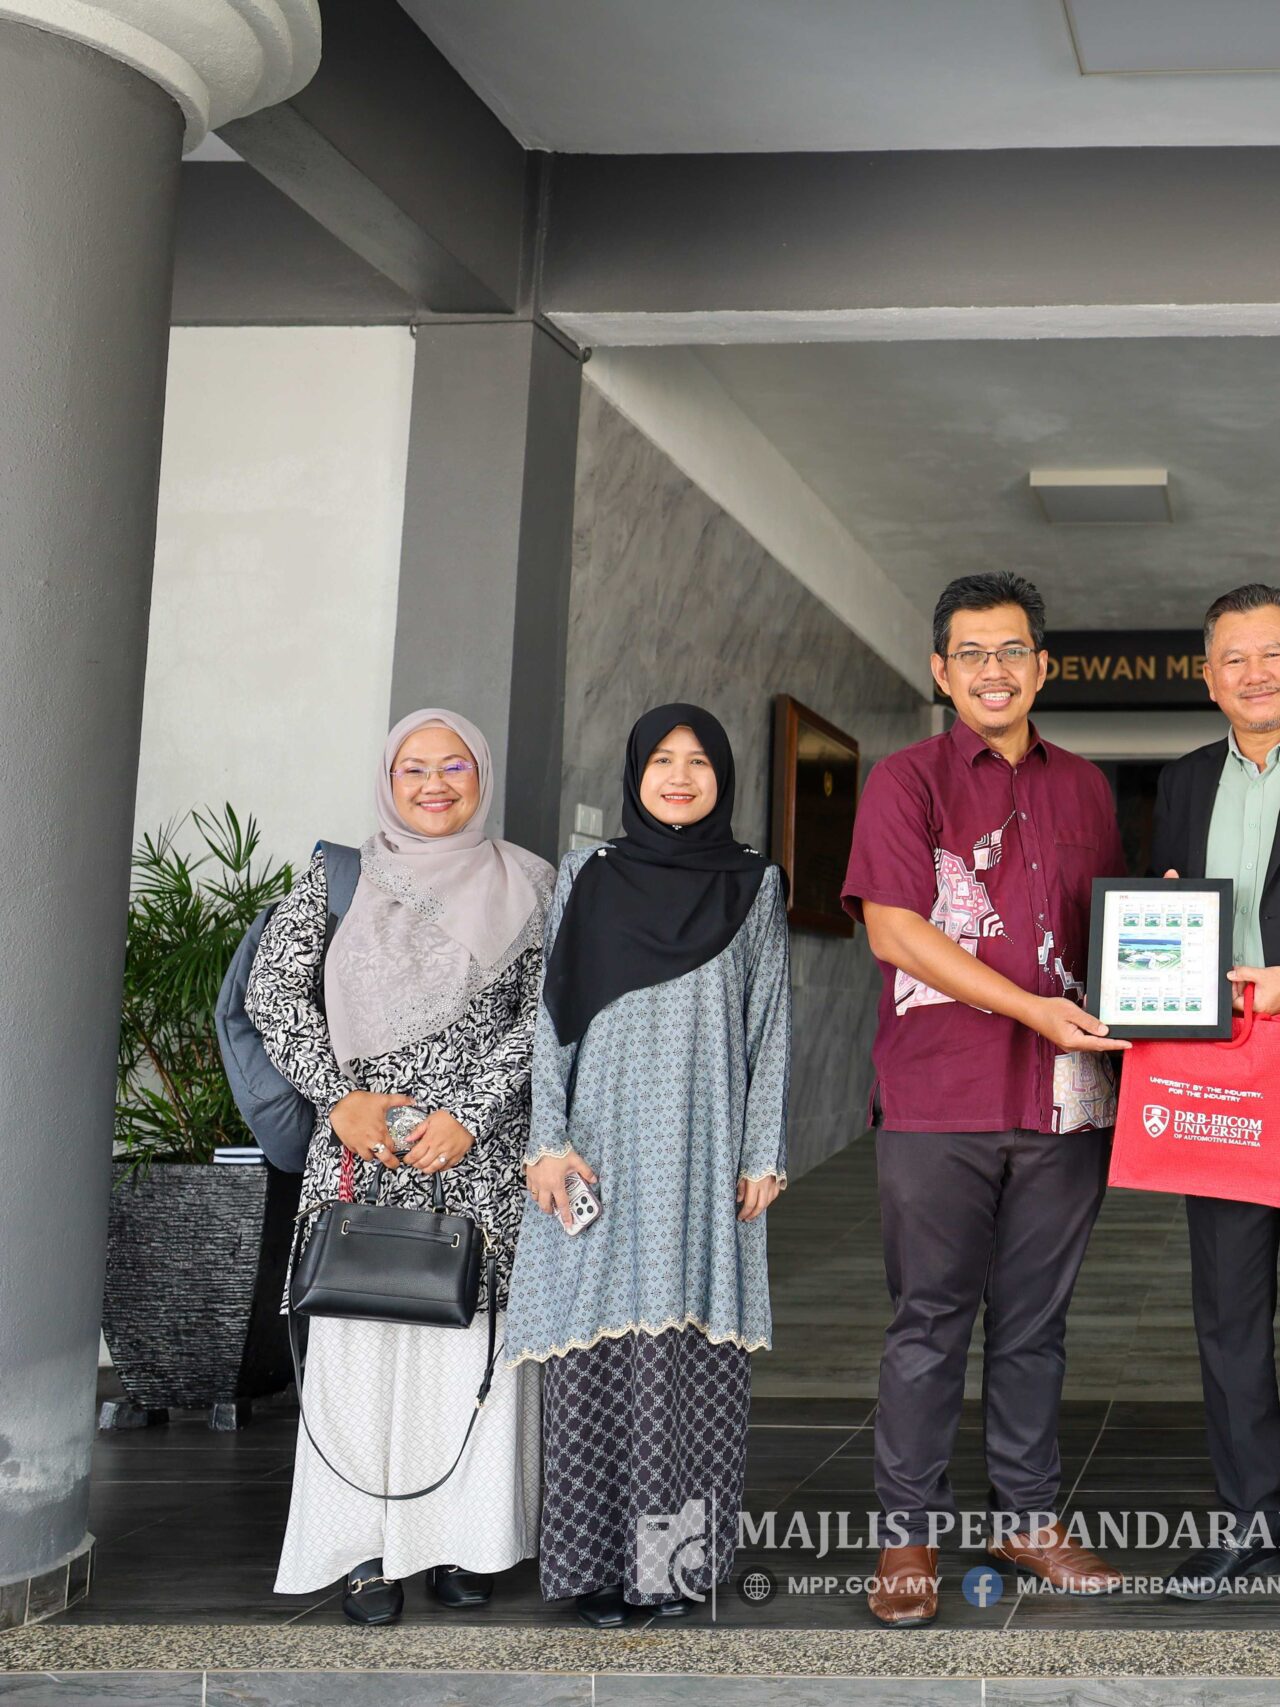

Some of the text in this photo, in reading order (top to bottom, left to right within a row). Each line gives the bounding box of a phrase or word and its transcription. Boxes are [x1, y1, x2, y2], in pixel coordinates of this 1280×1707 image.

[1046, 655, 1156, 680] DEWAN
[1149, 1076, 1190, 1089] UNIVERSITY
[1207, 1086, 1222, 1094] THE
[1168, 1087, 1241, 1103] FOR THE INDUSTRY
[1174, 1109, 1262, 1130] DRB-HICOM
[1174, 1122, 1262, 1141] UNIVERSITY
[1184, 1134, 1227, 1144] AUTOMOTIVE
[1228, 1139, 1261, 1147] MALAYSIA
